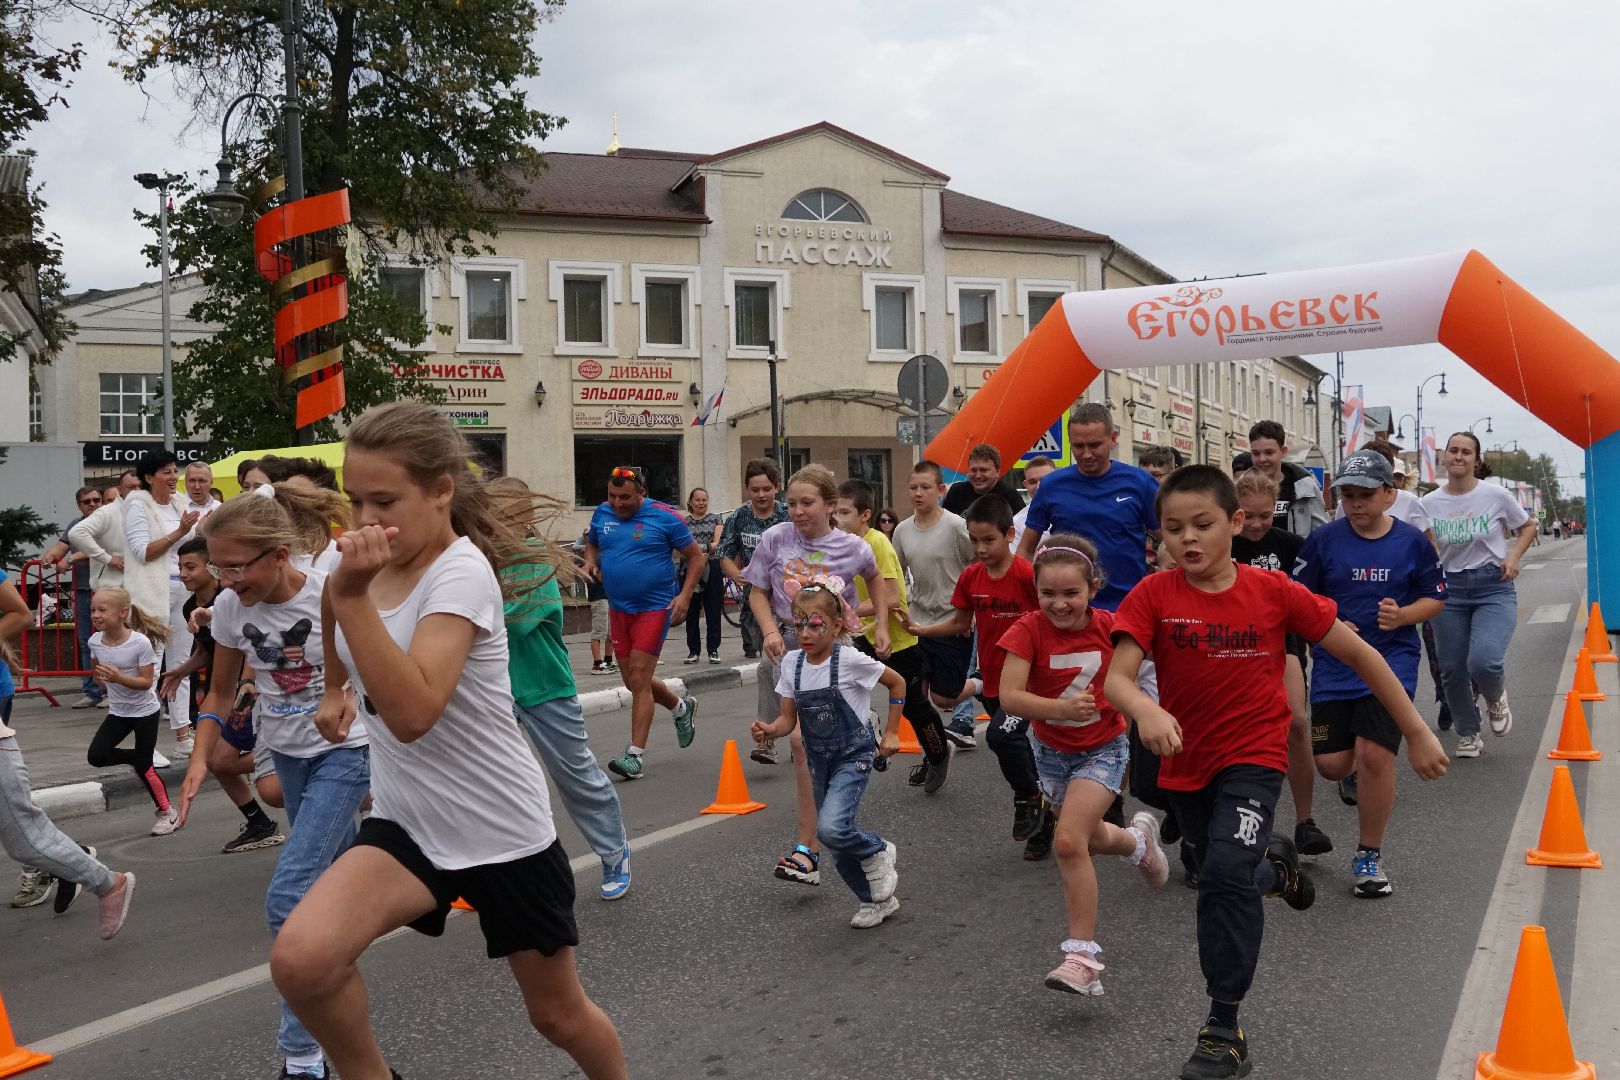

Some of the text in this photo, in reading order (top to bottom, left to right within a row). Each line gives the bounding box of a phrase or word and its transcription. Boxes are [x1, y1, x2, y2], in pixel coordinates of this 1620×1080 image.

[755, 223, 892, 242] ЕГОРЬЕВСКИЙ
[755, 240, 893, 268] ПАССАЖ
[1127, 291, 1380, 346] Егорьевск
[1227, 325, 1385, 345] Гордимся традициями Строим будущее
[608, 366, 673, 379] ДИВАНЫ
[580, 387, 679, 401] ЭЛЬДОРАДО.RU
[605, 408, 684, 427] Подружка
[102, 445, 235, 462] Егорвсй
[1433, 514, 1489, 539] BROOKLYN
[1292, 555, 1308, 576] 7
